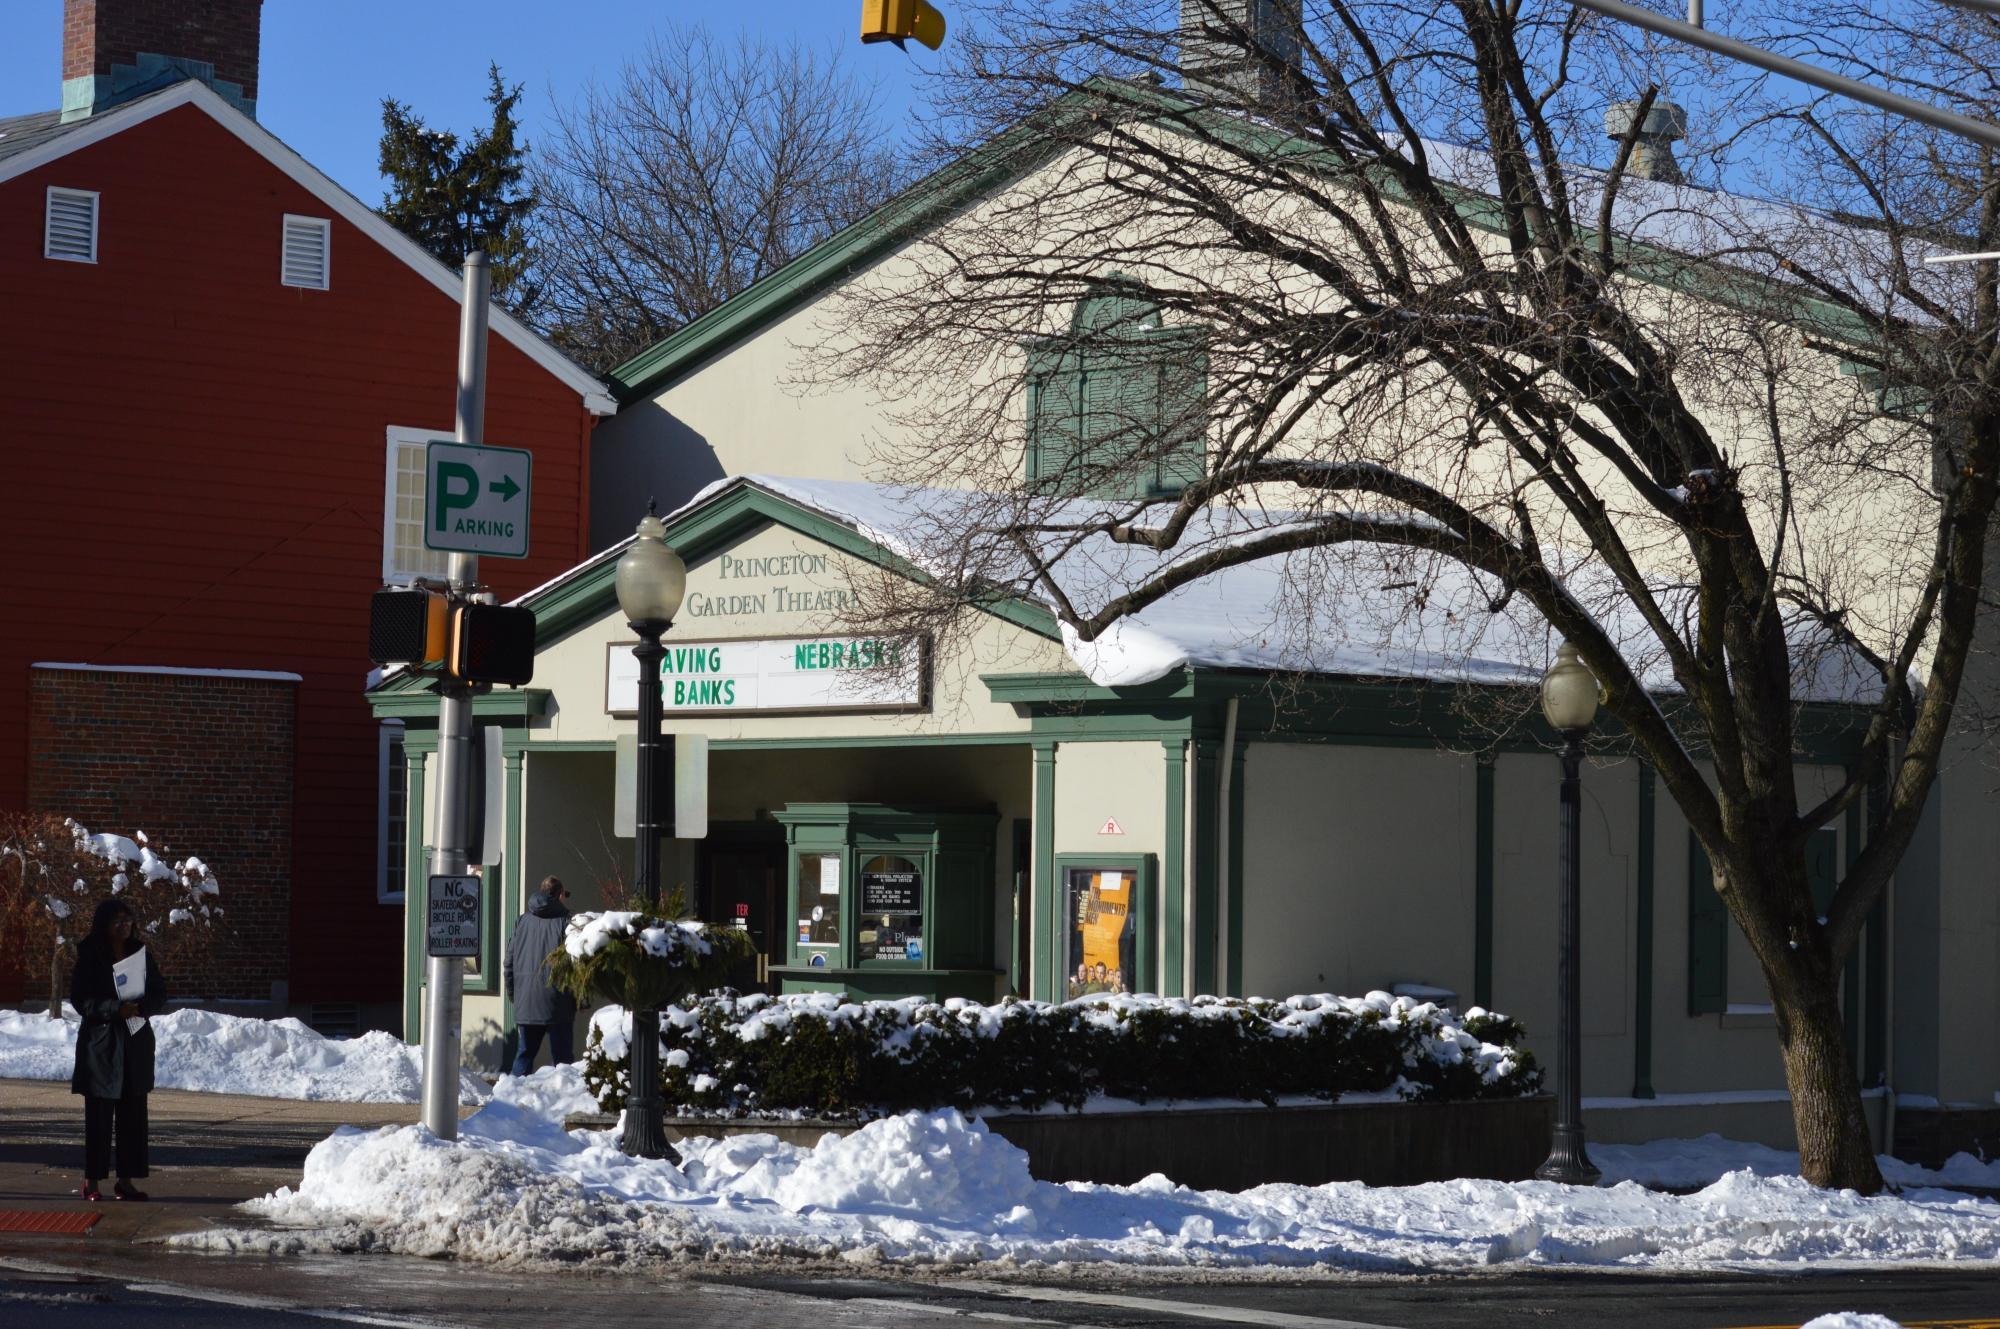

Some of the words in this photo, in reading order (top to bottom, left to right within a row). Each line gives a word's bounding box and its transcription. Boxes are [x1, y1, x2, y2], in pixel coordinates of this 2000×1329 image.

[687, 592, 766, 617] GARDEN
[662, 647, 721, 673] AVING
[674, 679, 735, 705] BANKS
[1107, 822, 1114, 833] R
[1087, 899, 1126, 916] MONUMENTS
[432, 912, 456, 922] BICYCLE
[448, 925, 461, 935] OR
[431, 937, 452, 948] ROLLER
[453, 937, 477, 948] SKATING
